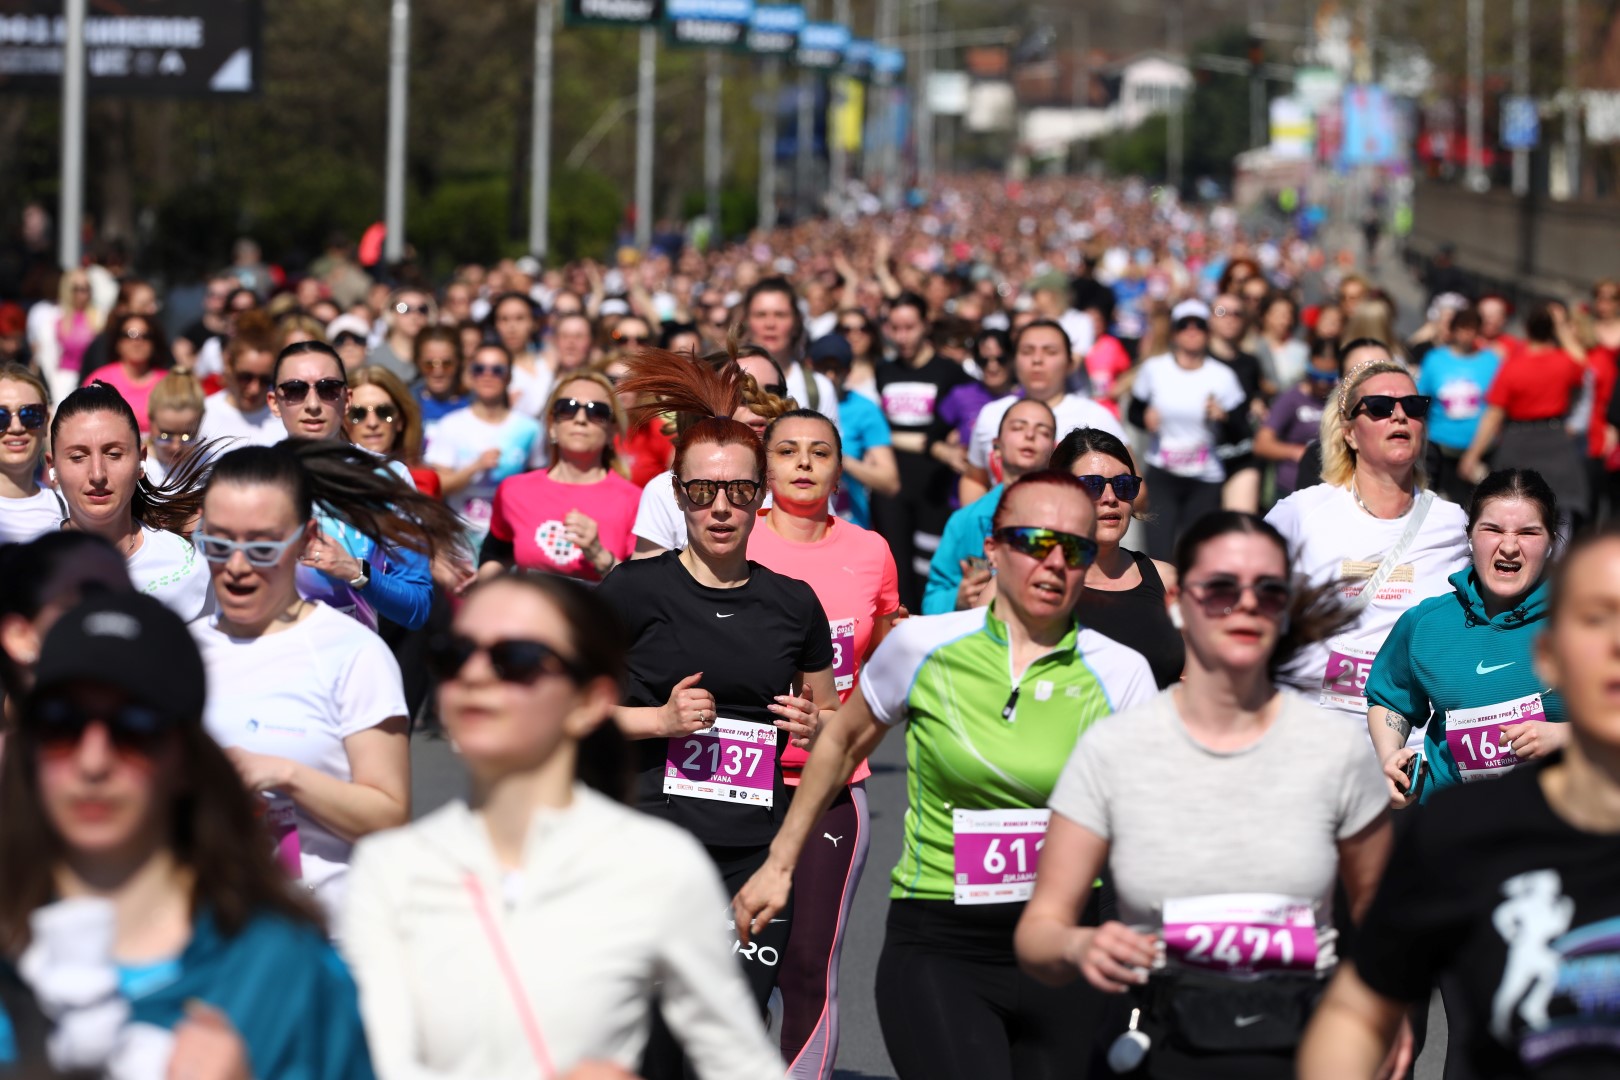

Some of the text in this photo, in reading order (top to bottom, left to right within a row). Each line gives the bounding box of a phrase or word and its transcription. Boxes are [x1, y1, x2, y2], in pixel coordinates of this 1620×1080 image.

[1338, 659, 1372, 690] 25
[1521, 703, 1540, 713] 2026
[682, 739, 763, 778] 2137
[1461, 731, 1516, 760] 164
[1485, 757, 1518, 767] KATERINA
[711, 774, 732, 783] IVANA
[983, 838, 1045, 874] 61
[1184, 924, 1294, 966] 2471
